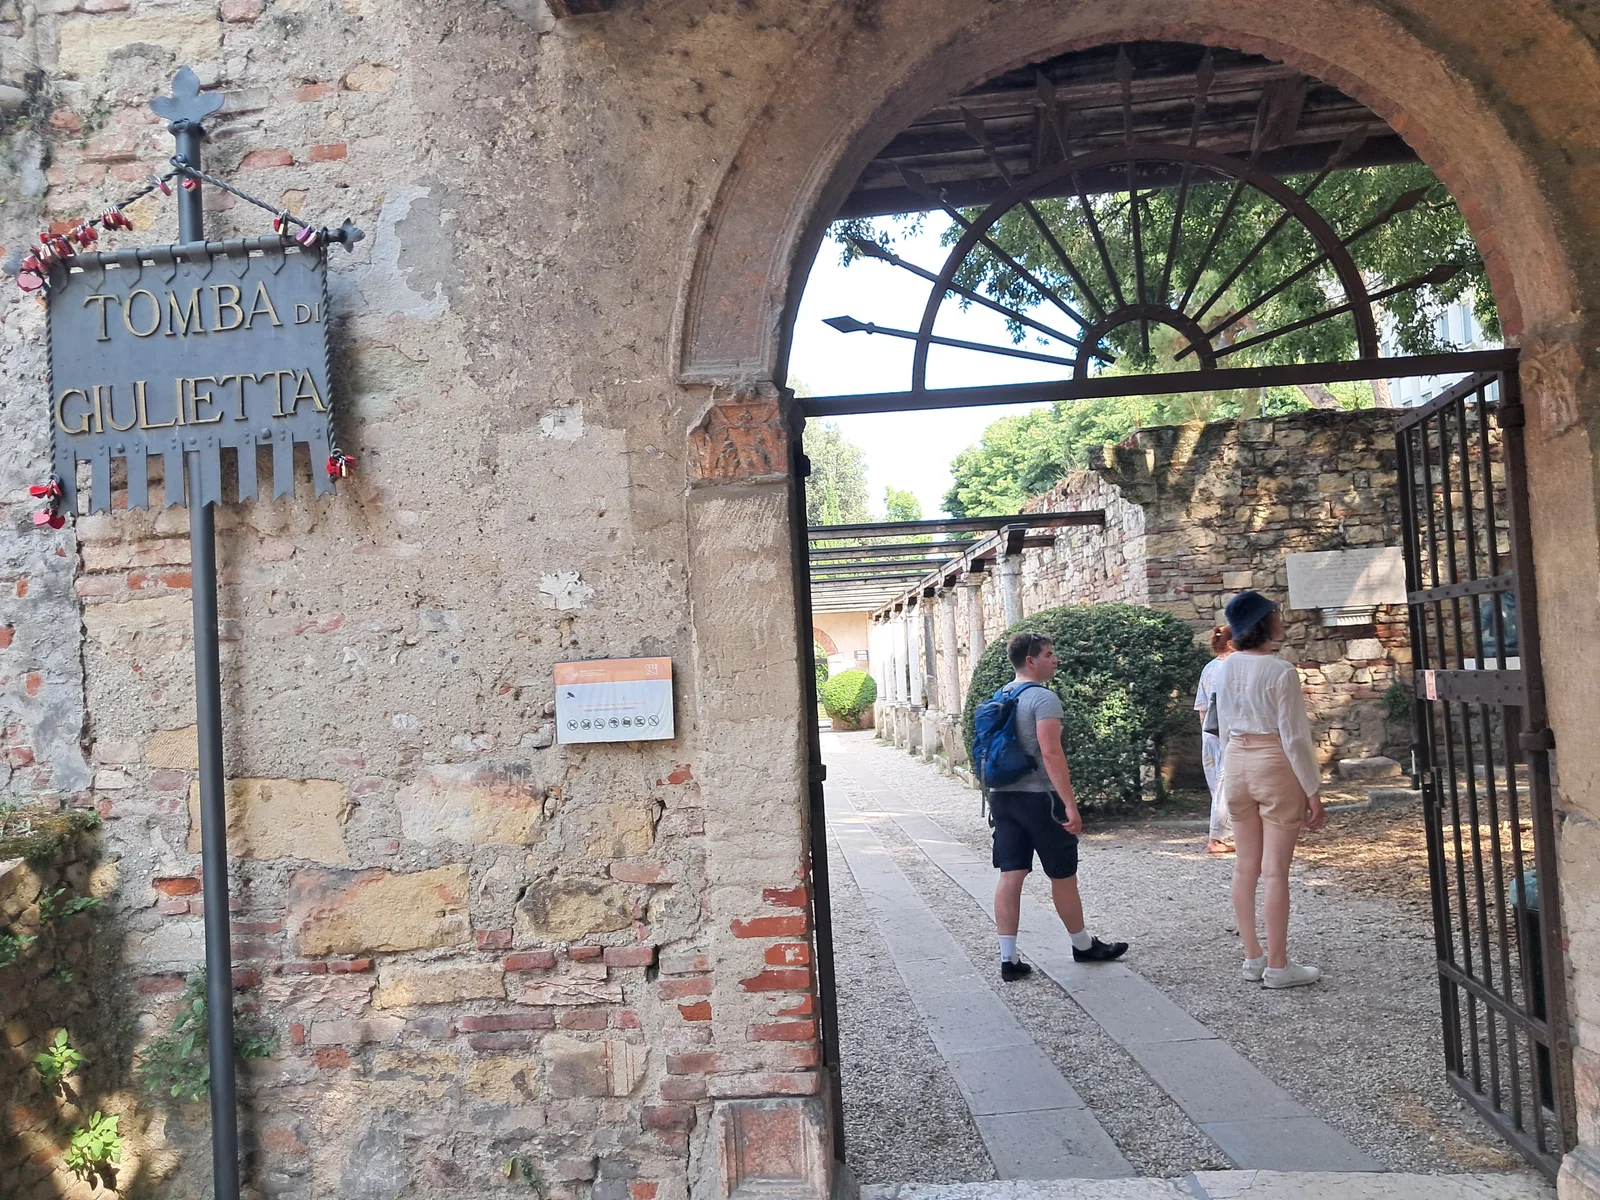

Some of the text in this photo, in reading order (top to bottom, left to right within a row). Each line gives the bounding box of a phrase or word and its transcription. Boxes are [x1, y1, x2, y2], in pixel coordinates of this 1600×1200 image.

[83, 280, 321, 341] TOMBA DI
[55, 367, 327, 435] GIULIETTA
